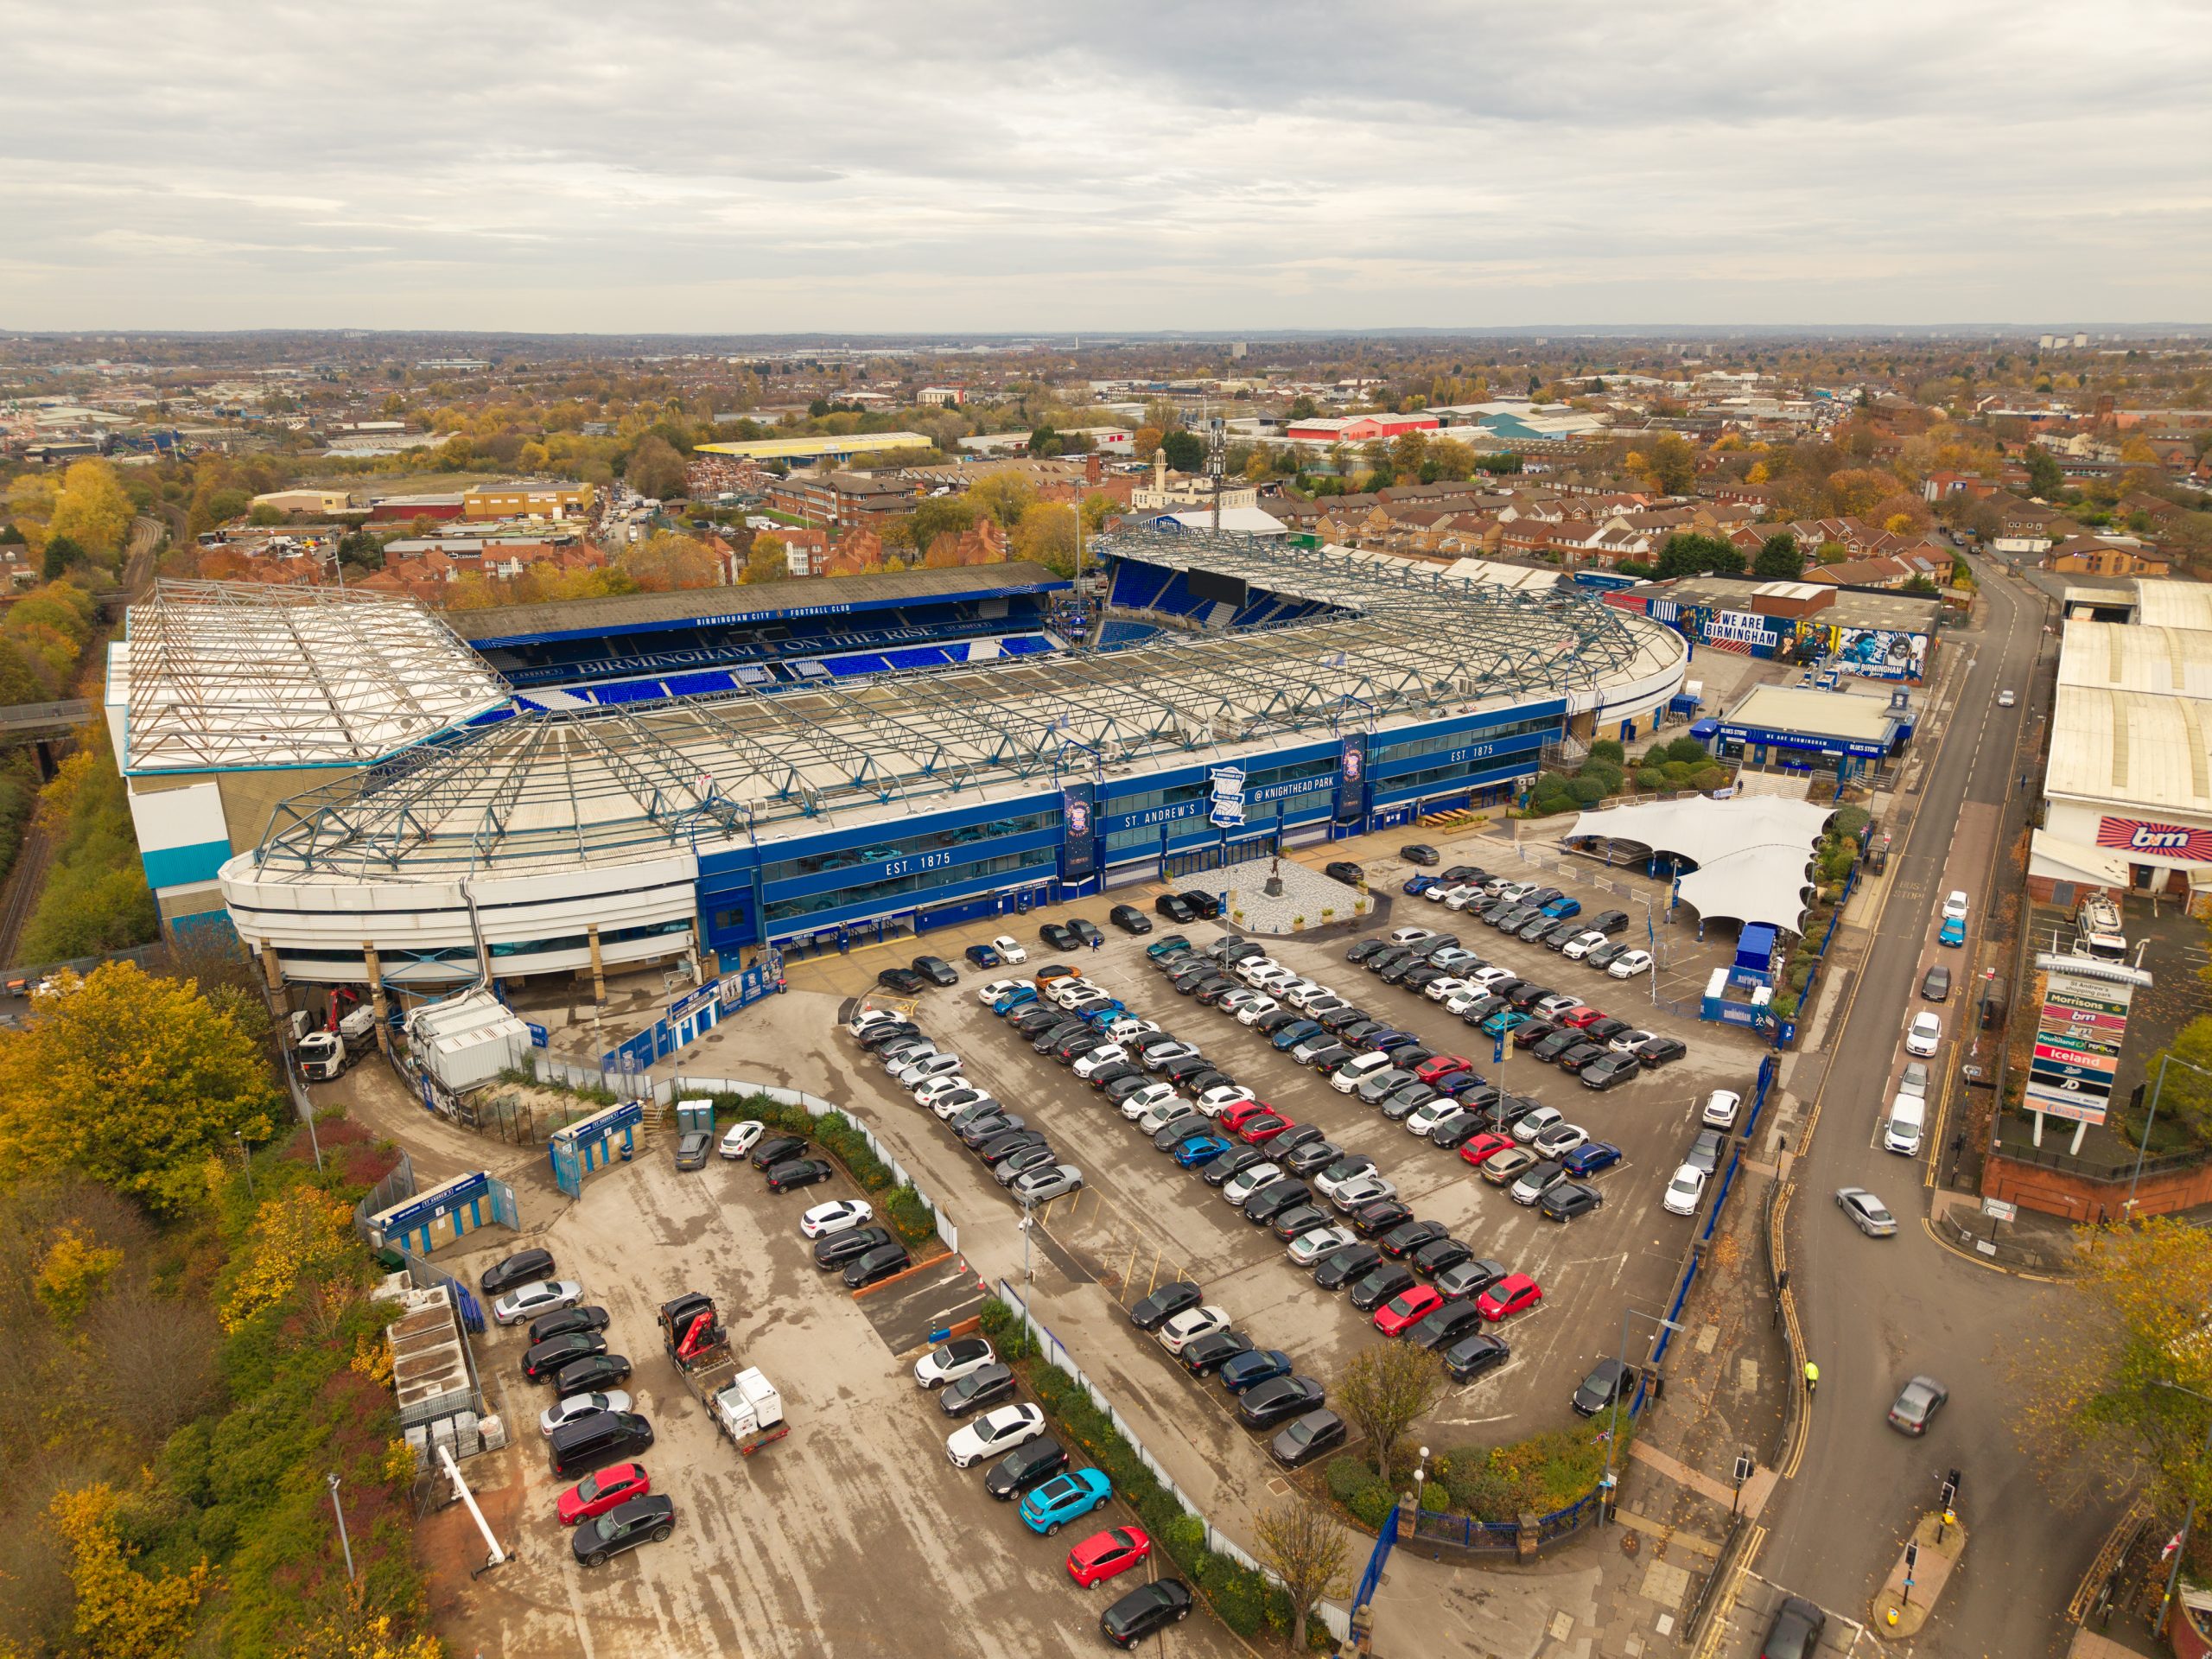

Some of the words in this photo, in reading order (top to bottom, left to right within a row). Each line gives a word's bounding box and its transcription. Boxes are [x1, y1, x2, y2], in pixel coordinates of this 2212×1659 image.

[791, 607, 828, 616] FOOTBALL
[831, 604, 850, 613] CLUB
[696, 614, 747, 626] BIRMINGHAM
[752, 612, 770, 620] CITY
[1722, 613, 1738, 626] WE
[1740, 615, 1762, 630] ARE
[1706, 624, 1776, 645] BIRMINGHAM
[573, 645, 757, 675] BIRMINGHAM
[784, 639, 823, 651] ON
[825, 631, 880, 646] THE
[881, 626, 938, 640] RISE
[1860, 664, 1902, 674] BIRMINGHAM
[1451, 749, 1468, 761] EST.
[1473, 745, 1493, 757] 1875
[1255, 790, 1263, 802] @
[1265, 779, 1313, 799] KNIGHTHEAD
[1314, 776, 1334, 790] PARK
[1125, 816, 1139, 828] ST.
[1144, 804, 1195, 823] ANDREW'S
[886, 861, 912, 875] EST.
[920, 852, 950, 868] 1875
[1898, 881, 1920, 890] BUS
[2065, 986, 2095, 996] shopping
[2051, 995, 2104, 1010] Morrisons
[2050, 1049, 2101, 1066] Iceland
[2061, 1078, 2080, 1090] JD
